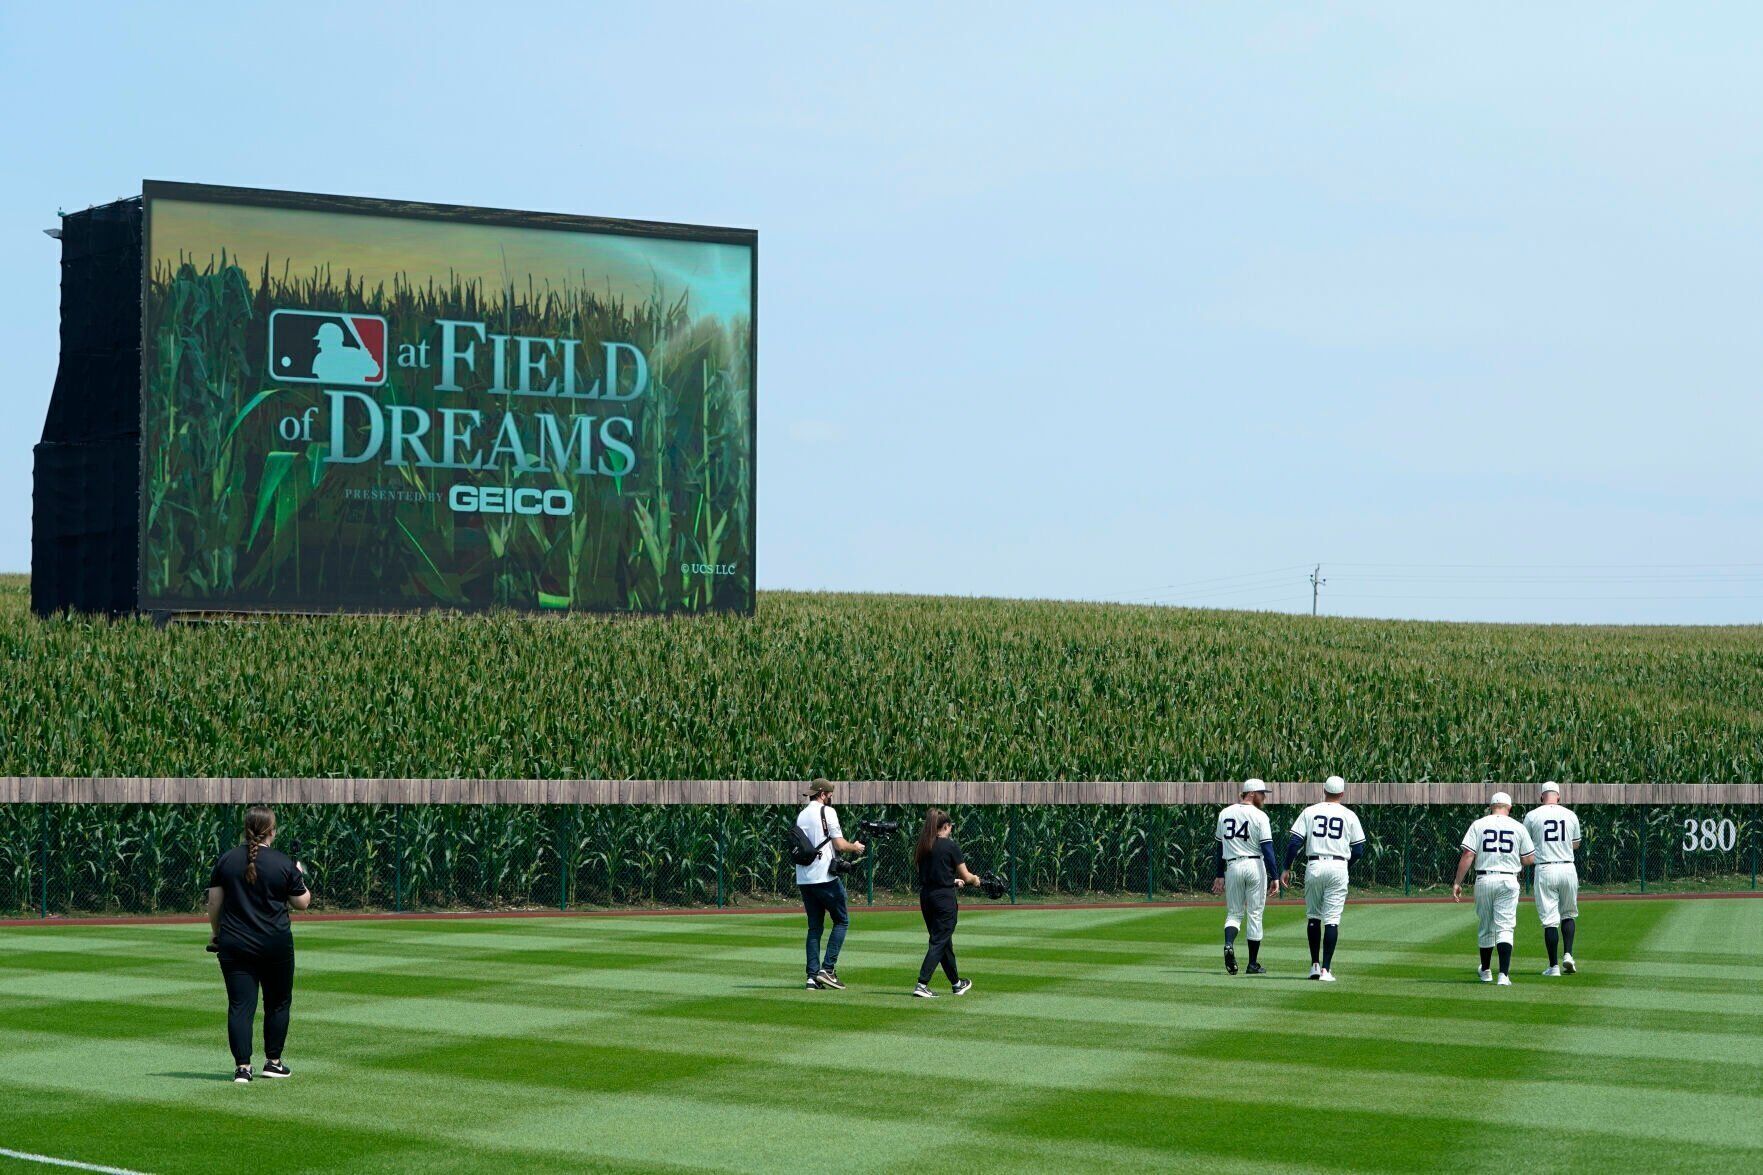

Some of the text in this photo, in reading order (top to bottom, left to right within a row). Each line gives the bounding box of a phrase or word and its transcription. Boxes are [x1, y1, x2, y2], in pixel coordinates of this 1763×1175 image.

[397, 319, 648, 400] at FIELD
[279, 390, 635, 476] of DREAMS
[345, 484, 574, 516] PRESENTED BY GEICO
[692, 563, 714, 575] UCS
[715, 563, 736, 575] LLC
[1223, 818, 1249, 842] 34
[1312, 814, 1344, 839] 39
[1543, 819, 1566, 842] 21
[1682, 819, 1737, 853] 380
[1482, 829, 1513, 853] 25
